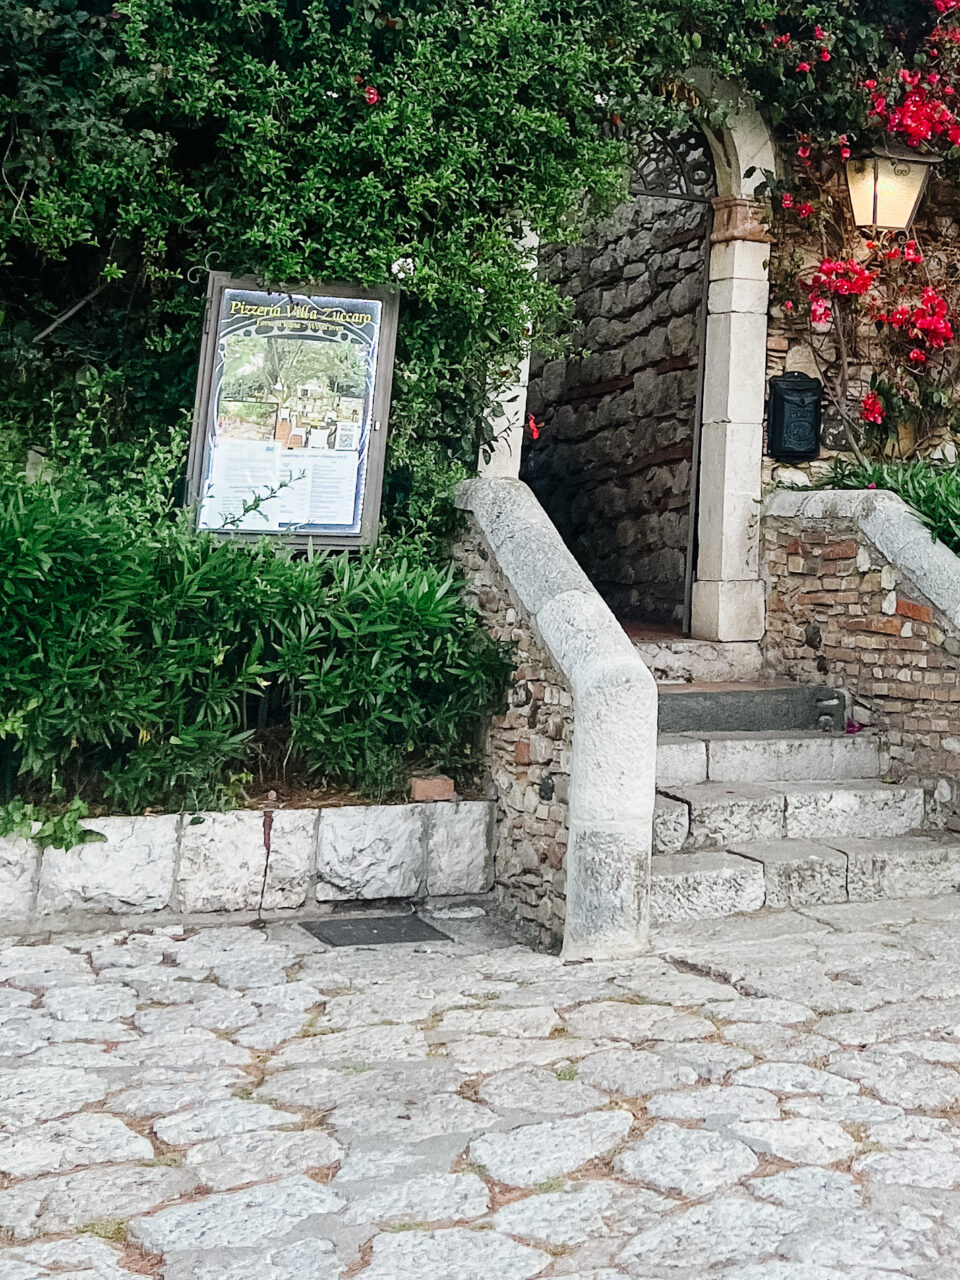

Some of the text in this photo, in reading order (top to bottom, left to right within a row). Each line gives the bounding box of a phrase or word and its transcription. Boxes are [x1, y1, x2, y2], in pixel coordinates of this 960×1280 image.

[229, 300, 372, 324] Pizzeria Villa Zuccaro
